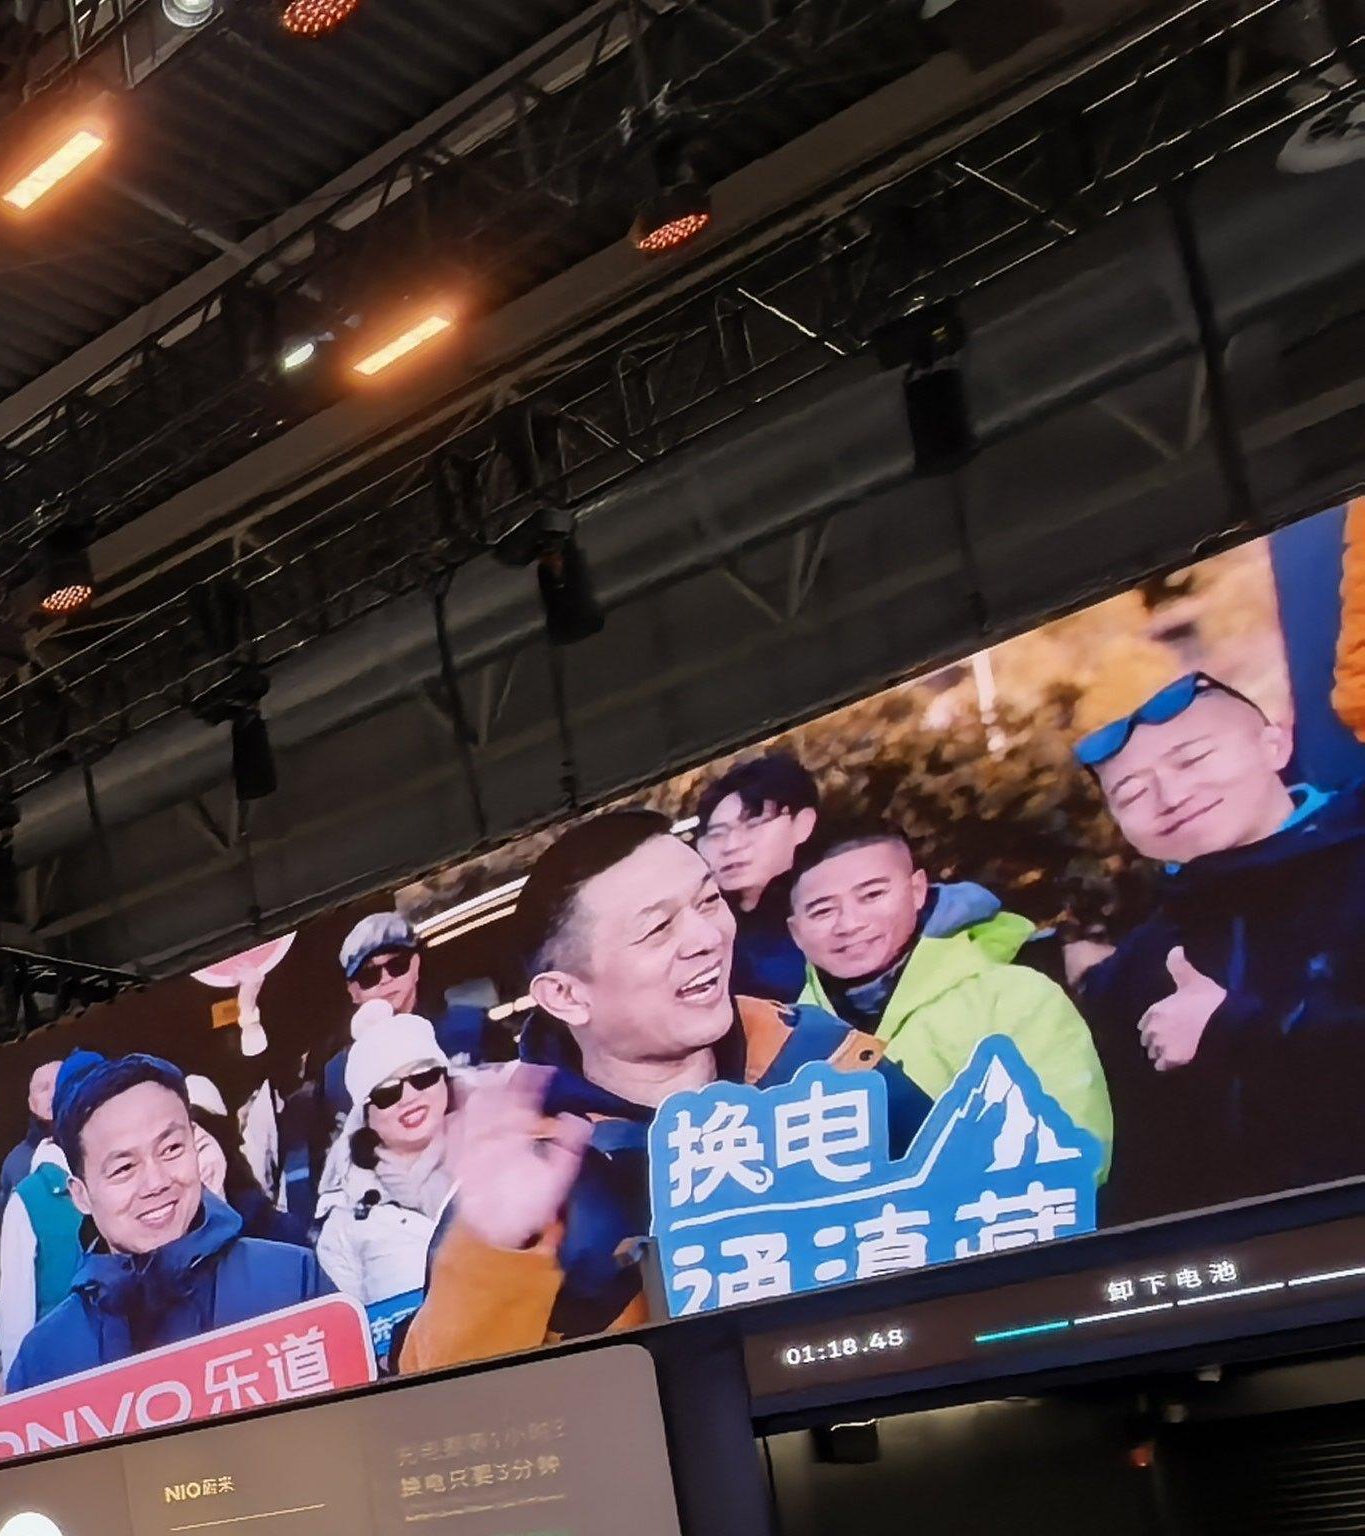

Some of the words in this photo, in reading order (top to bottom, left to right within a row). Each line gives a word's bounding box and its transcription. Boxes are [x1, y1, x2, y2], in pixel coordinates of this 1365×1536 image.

[669, 1081, 873, 1207] 换电
[1107, 1261, 1237, 1302] 卸下电池
[786, 1328, 905, 1366] 01:18.48
